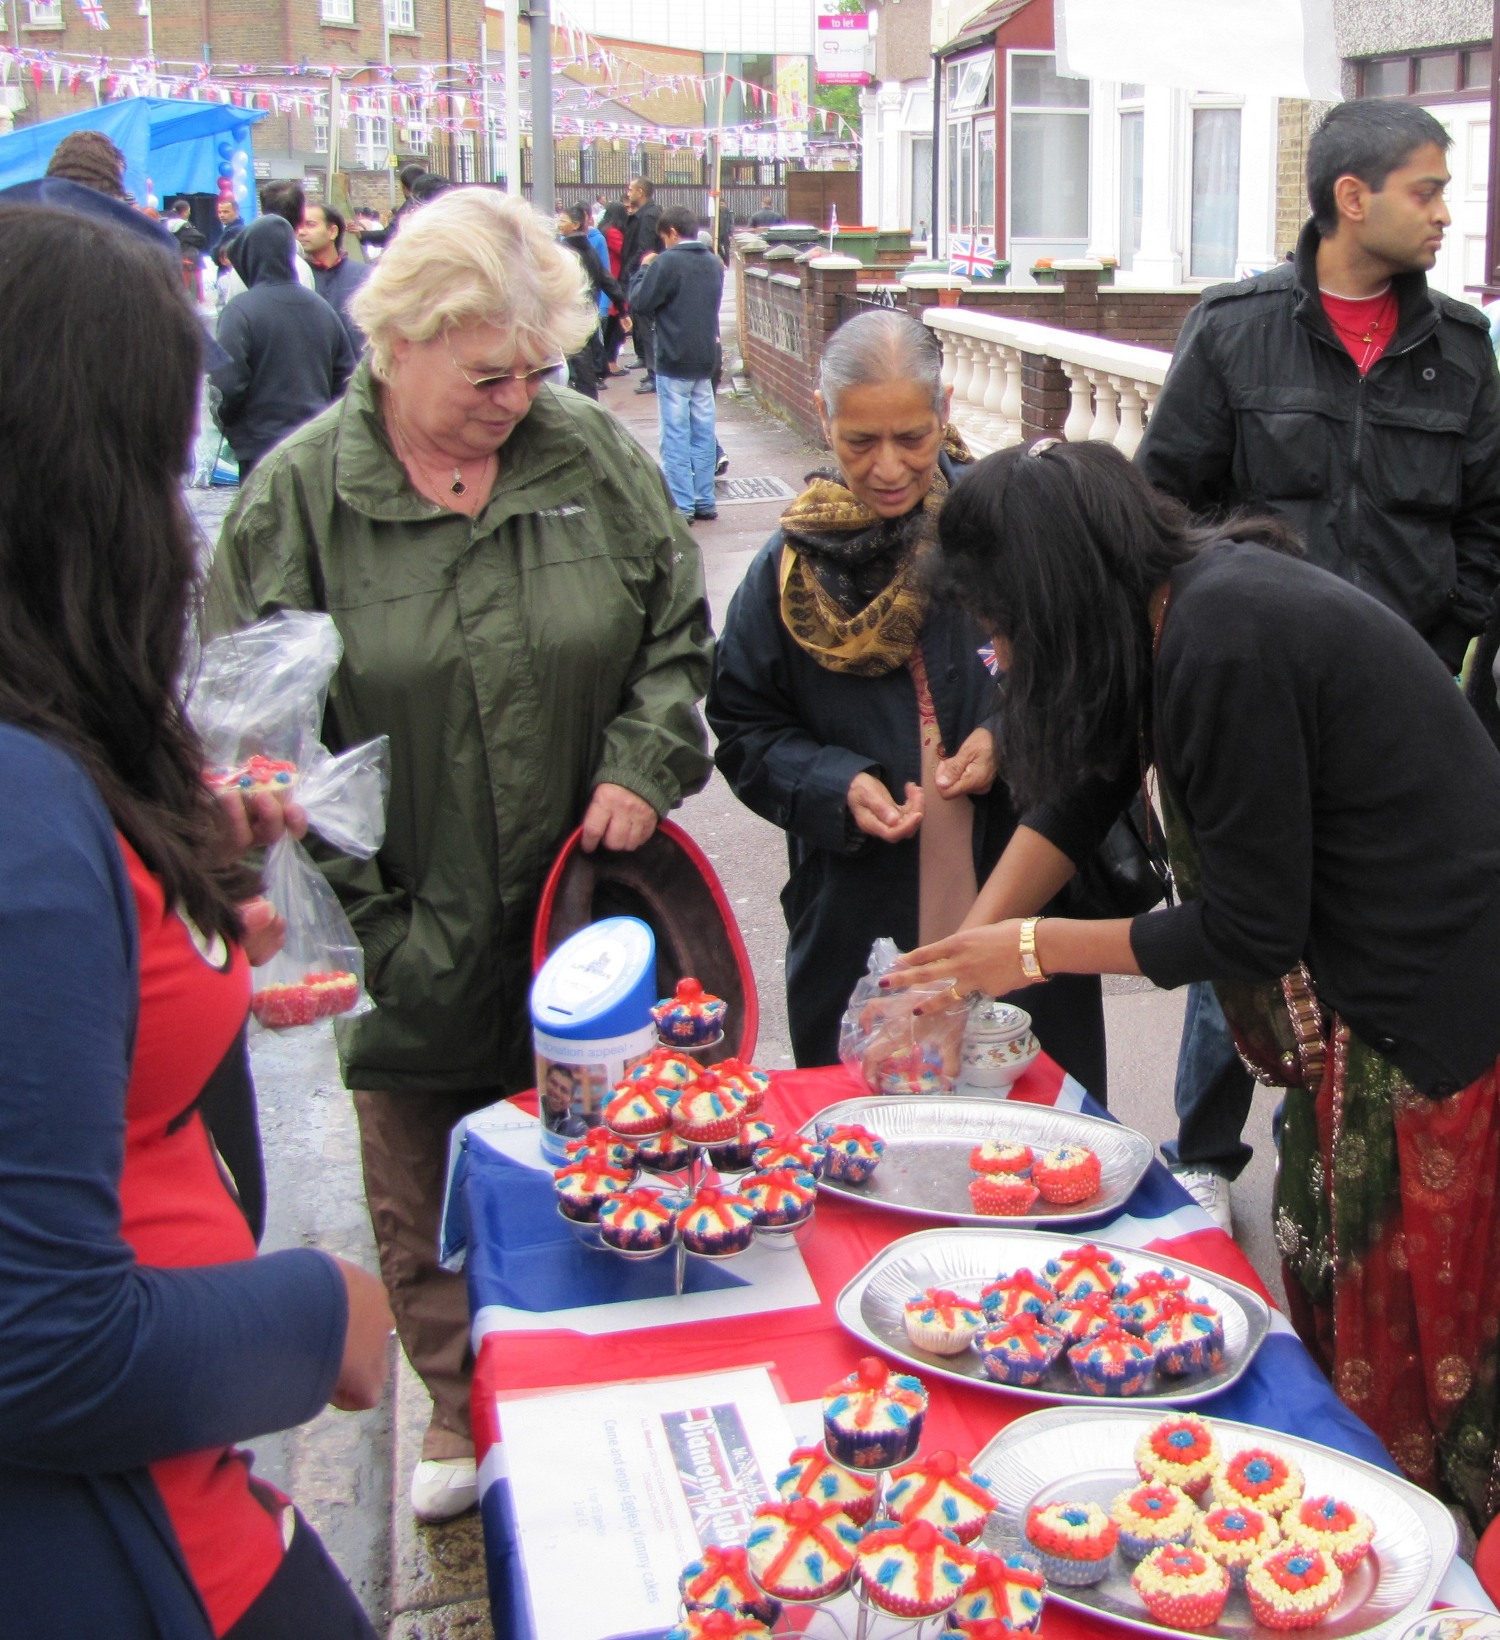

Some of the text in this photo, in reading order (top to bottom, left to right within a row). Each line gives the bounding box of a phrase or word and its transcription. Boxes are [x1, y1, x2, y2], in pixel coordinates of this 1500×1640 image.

[832, 17, 854, 28] to let
[587, 1043, 627, 1058] appeal
[679, 1418, 751, 1548] Diamond Jubi
[744, 1473, 767, 1507] celebrat
[605, 1419, 660, 1603] Come and enjoy Eggless Yummy cakes
